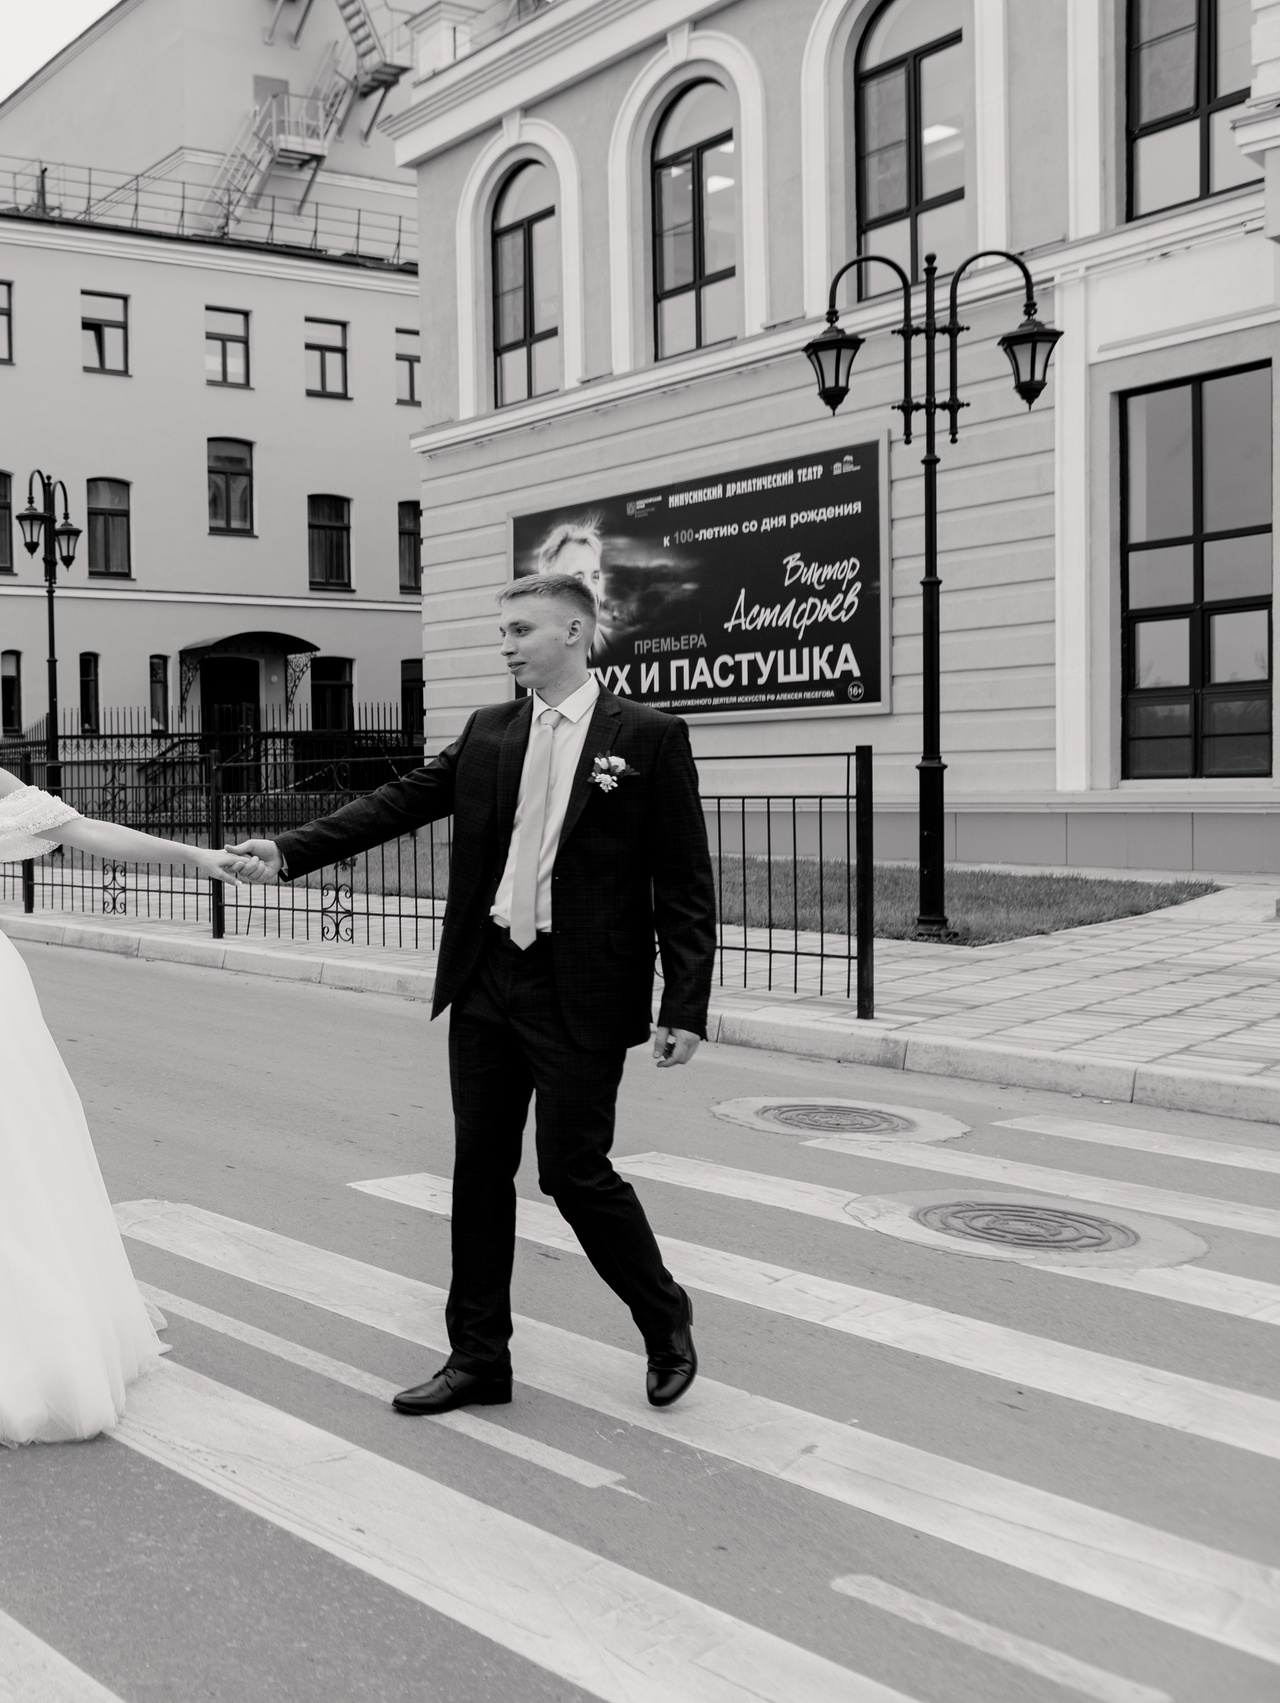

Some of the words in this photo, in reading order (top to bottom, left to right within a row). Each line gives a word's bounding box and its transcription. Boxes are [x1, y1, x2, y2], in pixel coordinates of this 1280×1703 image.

[668, 483, 723, 509] МИНУСИНСКИЙ
[726, 468, 794, 498] ДРАМАТИЧЕСКИЙ
[797, 464, 824, 483] ТЕАТР
[674, 522, 739, 545] 100-летию
[741, 519, 759, 534] со
[760, 514, 787, 533] дня
[790, 500, 862, 529] рождения
[782, 551, 860, 591] Виктор
[723, 580, 862, 641] Астафьев
[634, 633, 707, 655] ПРЕМЬЕРА
[640, 661, 660, 694] И
[670, 643, 861, 691] ПАСТУШКА
[766, 692, 776, 702] РФ
